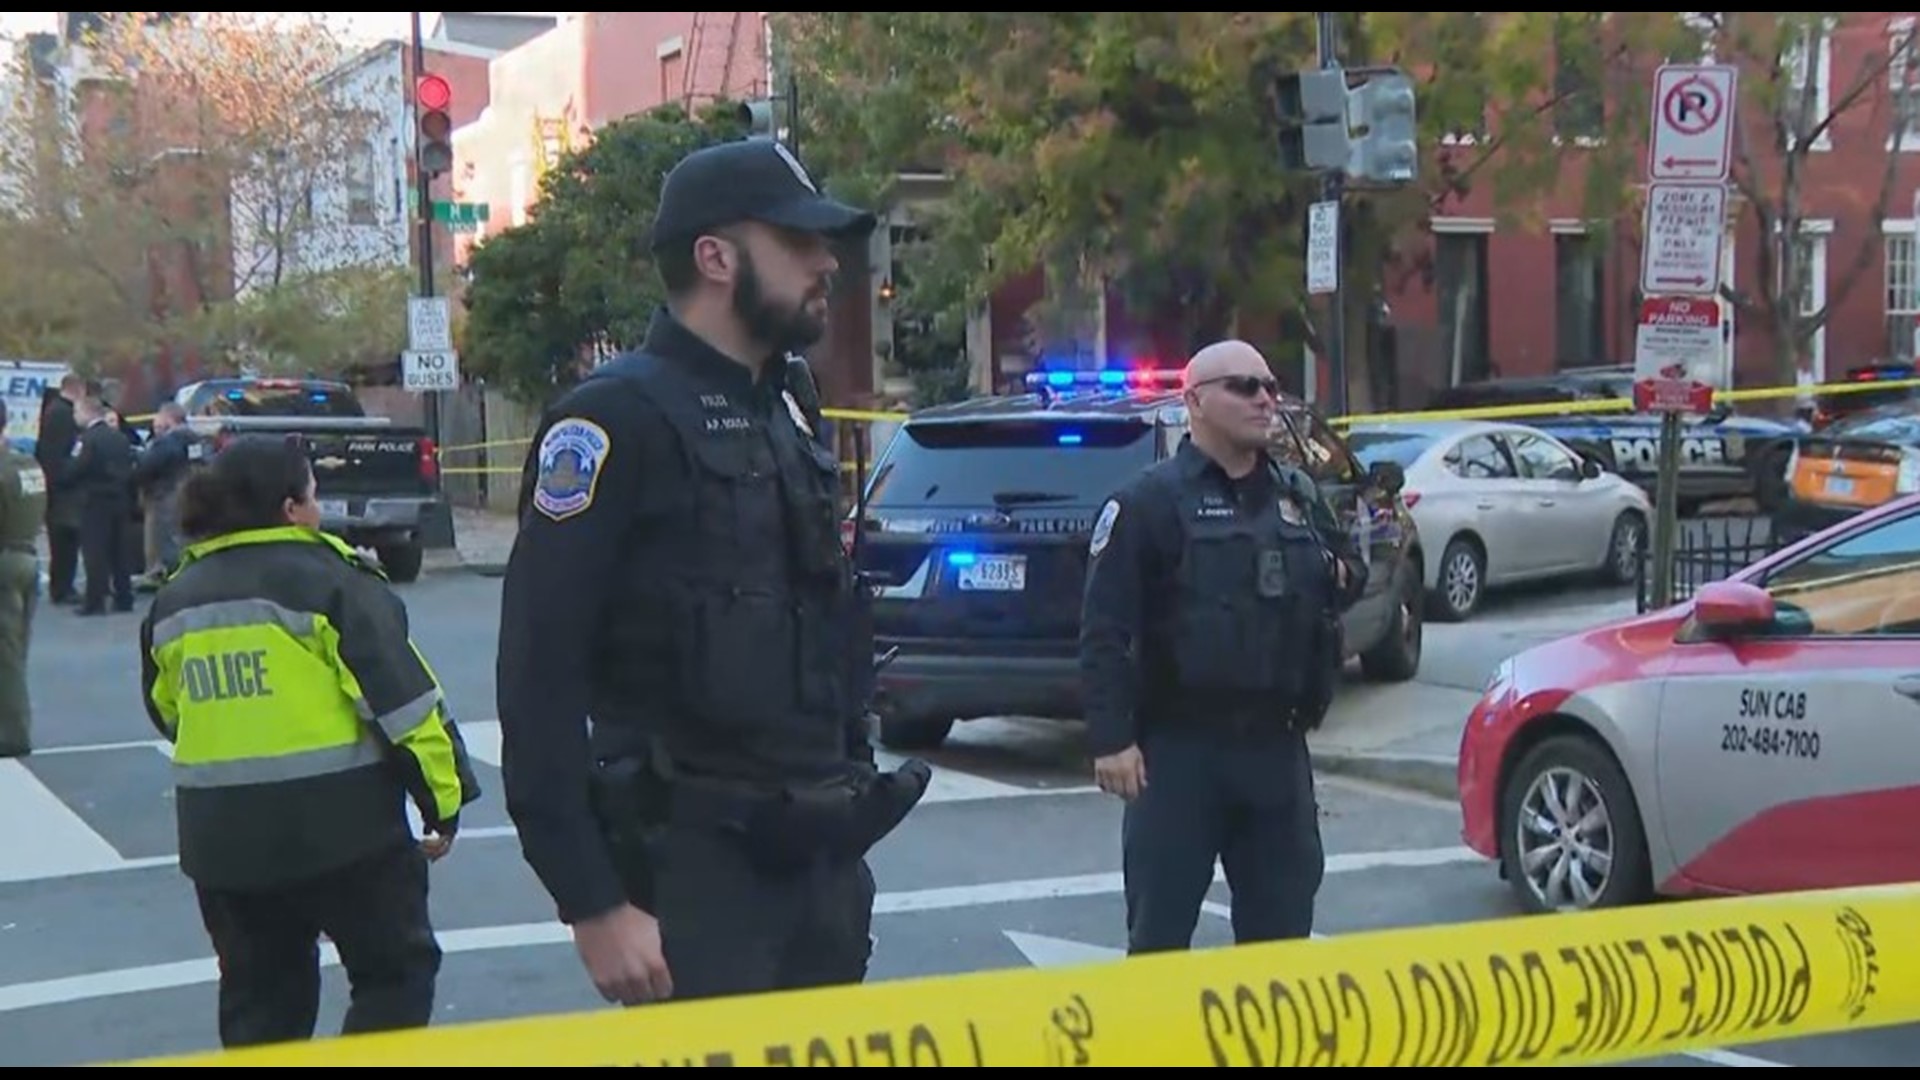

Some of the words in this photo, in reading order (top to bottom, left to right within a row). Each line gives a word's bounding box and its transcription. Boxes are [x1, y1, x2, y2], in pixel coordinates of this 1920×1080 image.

[1648, 313, 1709, 325] PARKING
[1668, 302, 1690, 313] NO
[417, 355, 445, 370] NO
[0, 377, 48, 397] EN
[408, 372, 453, 386] BUSES
[348, 442, 377, 452] PARK
[378, 442, 415, 452] POLICE
[1611, 439, 1723, 472] POCE
[181, 649, 273, 703] OLICE
[1740, 689, 1771, 718] SUN
[1774, 691, 1807, 720] CAB
[1721, 724, 1821, 759] 202-484-7100
[1659, 921, 1812, 1040] POLICE
[1486, 951, 1556, 1066] DO
[1554, 938, 1661, 1057] LINE
[1200, 971, 1372, 1067] CROSS
